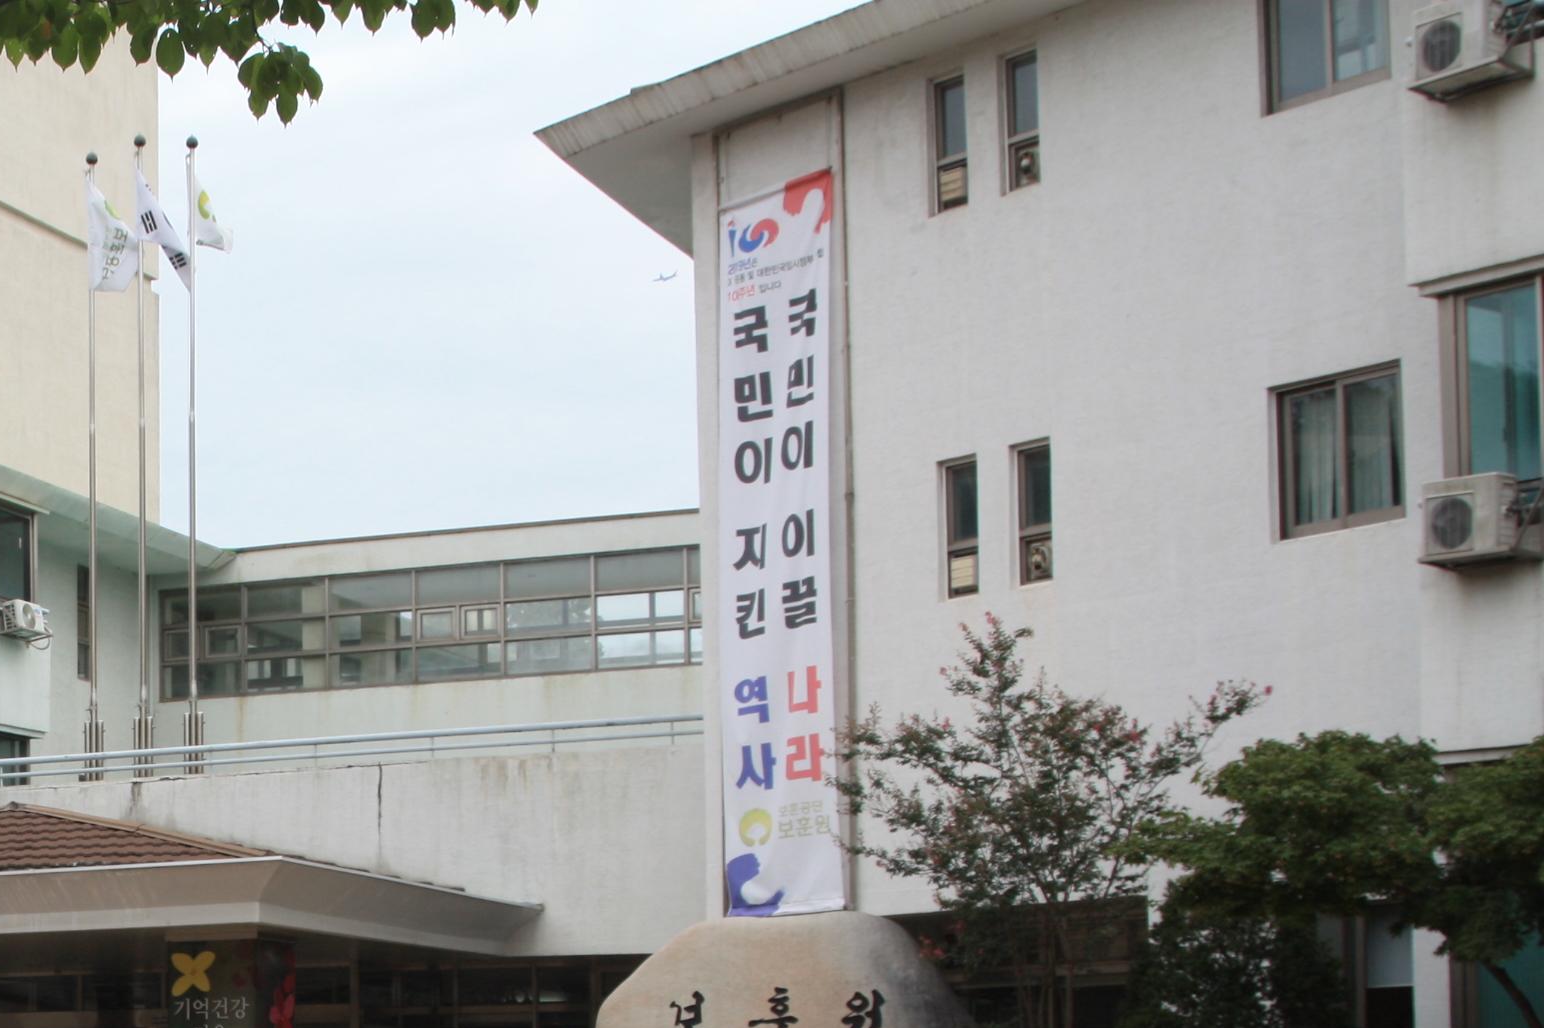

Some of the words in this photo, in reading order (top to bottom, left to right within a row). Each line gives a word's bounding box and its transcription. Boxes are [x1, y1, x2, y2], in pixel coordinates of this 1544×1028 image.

[733, 304, 773, 484] 국민이
[780, 287, 818, 470] 국민이
[732, 522, 769, 640] 지킨
[781, 508, 818, 629] 이끌
[733, 674, 777, 791] 역사
[784, 664, 825, 782] 나라
[778, 814, 831, 840] 보훈원
[173, 997, 251, 1020] 기억건강
